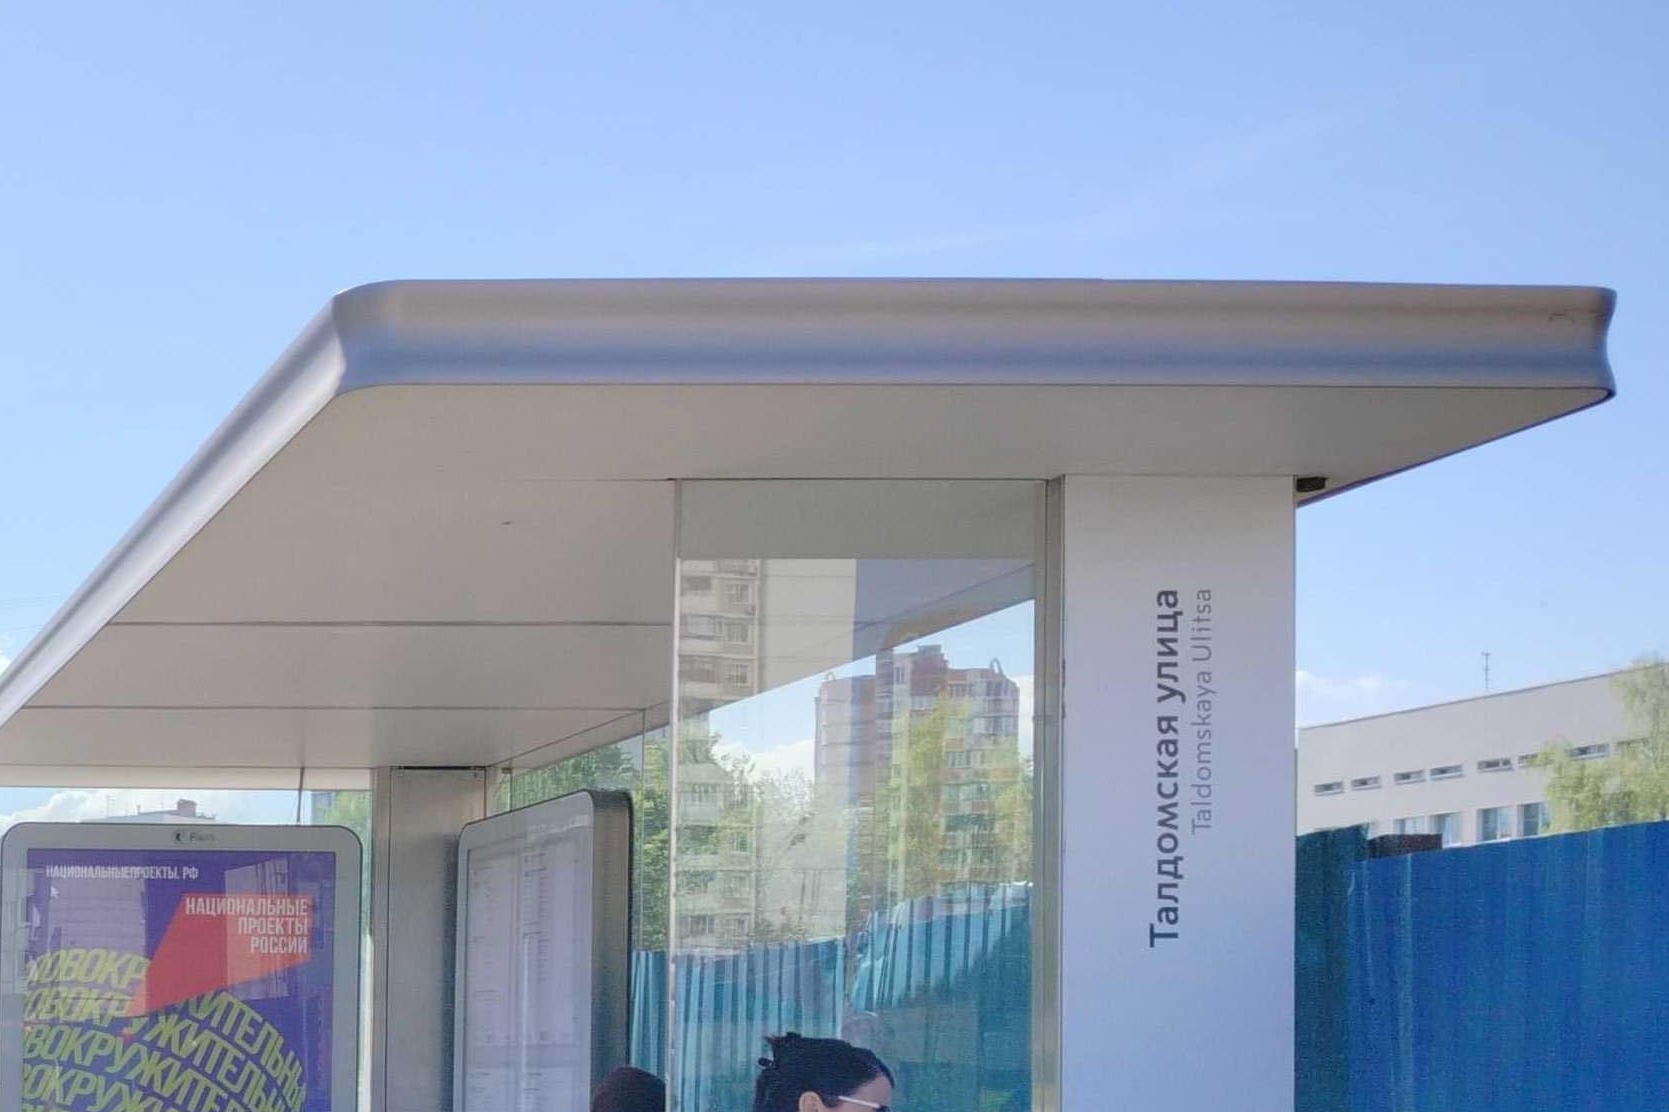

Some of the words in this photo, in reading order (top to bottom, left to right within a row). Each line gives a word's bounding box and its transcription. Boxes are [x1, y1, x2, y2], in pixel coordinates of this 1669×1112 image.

[1156, 589, 1186, 703] улица
[1190, 588, 1212, 661] Ulitsa
[1190, 671, 1217, 835] Taldomskaya
[1149, 714, 1184, 948] Талдомская
[185, 897, 308, 916] НАЦИОНАЛЬНЫЕ
[238, 917, 308, 935] ПРОЕКТЫ
[250, 936, 308, 954] РОССИИ
